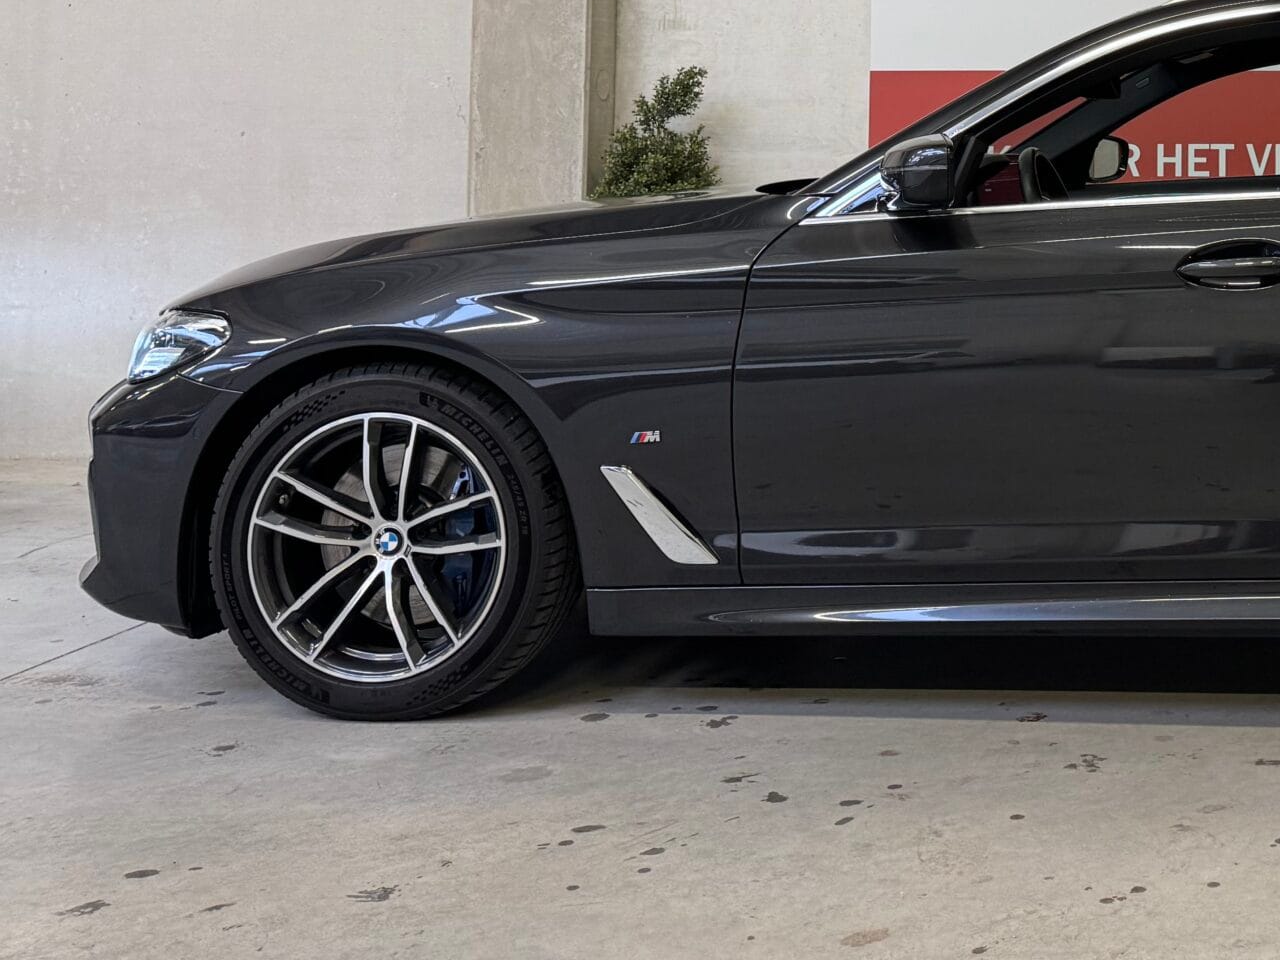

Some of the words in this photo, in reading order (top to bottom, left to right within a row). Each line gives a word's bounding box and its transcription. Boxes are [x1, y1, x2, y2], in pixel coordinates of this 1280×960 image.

[1157, 144, 1235, 177] HET
[439, 400, 508, 468] MICHELIN
[241, 625, 307, 693] MICHELIN
